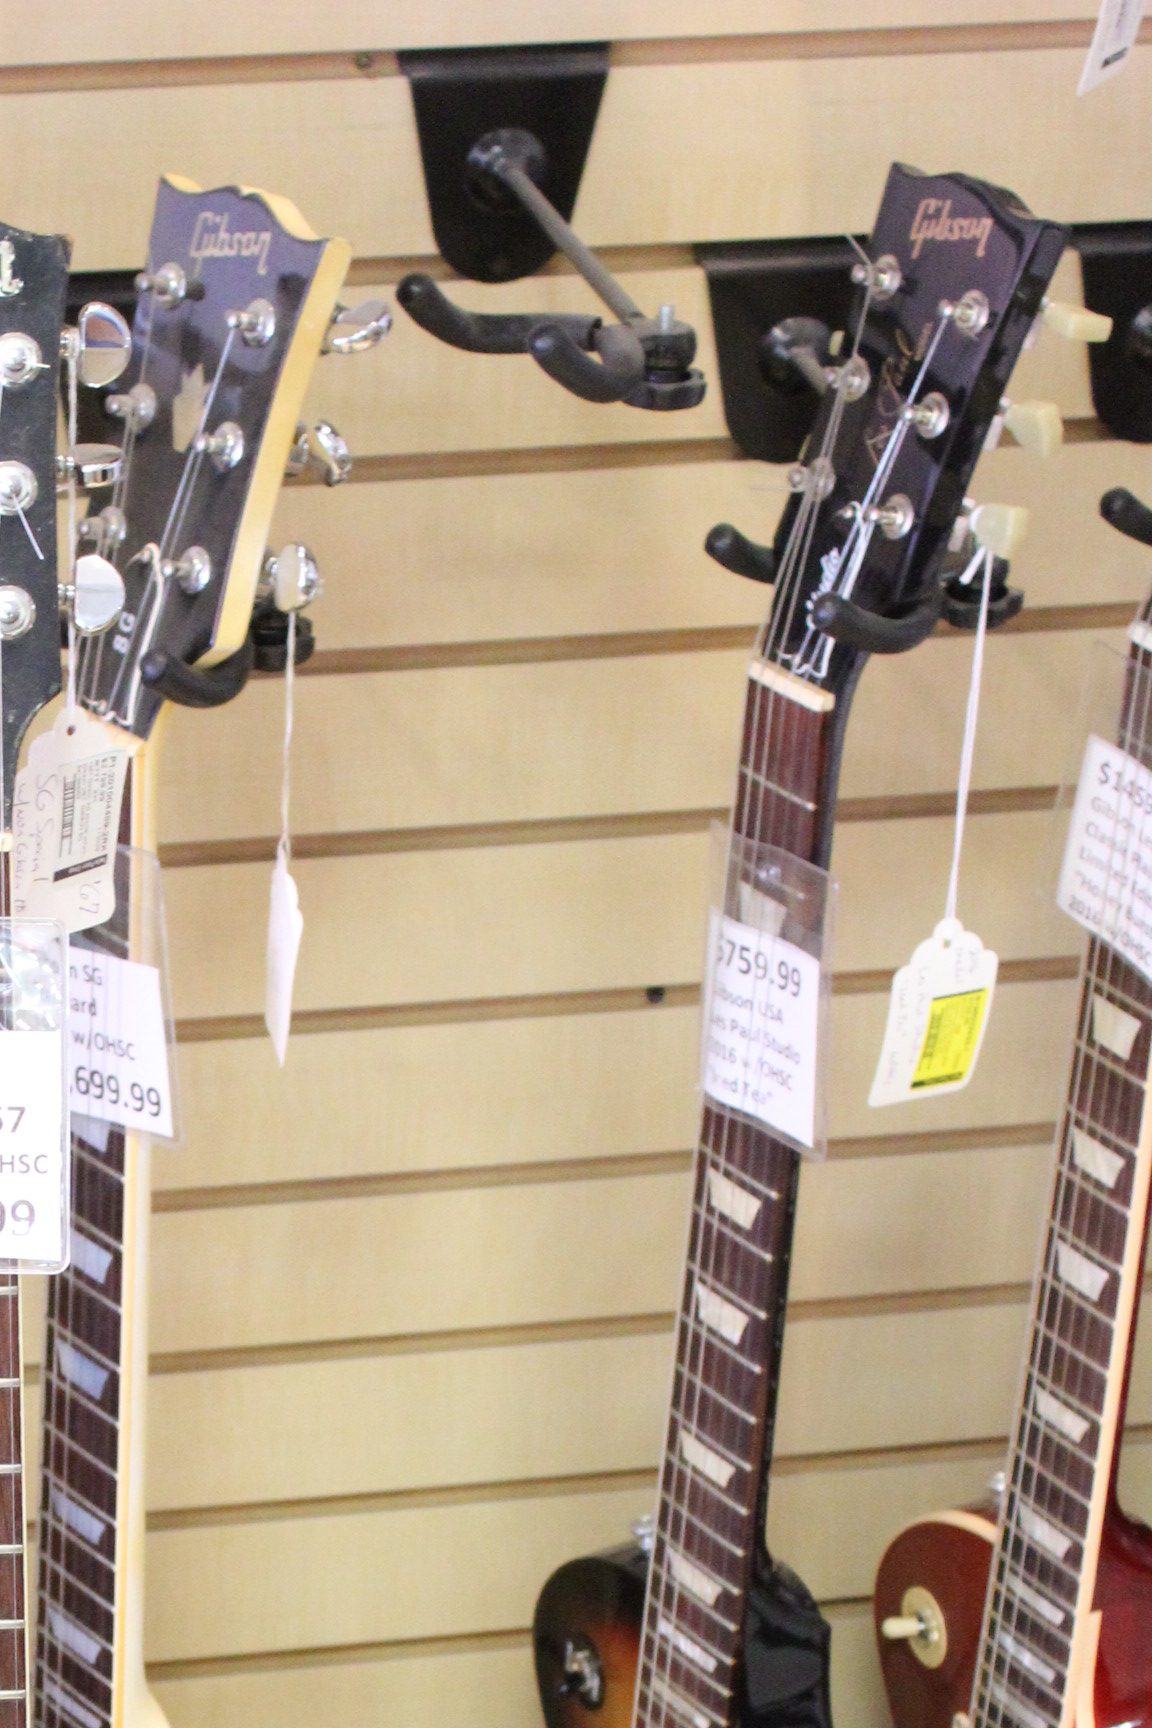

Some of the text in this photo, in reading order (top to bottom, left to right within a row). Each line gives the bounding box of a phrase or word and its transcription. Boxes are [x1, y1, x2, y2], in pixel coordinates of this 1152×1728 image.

[190, 210, 272, 276] Gibson
[910, 198, 994, 259] Gibson
[82, 964, 103, 987] SG
[758, 1001, 785, 1025] USA
[71, 1027, 136, 1061] w/OHSC
[730, 1018, 760, 1043] Paul
[70, 1065, 162, 1118] ,699.99
